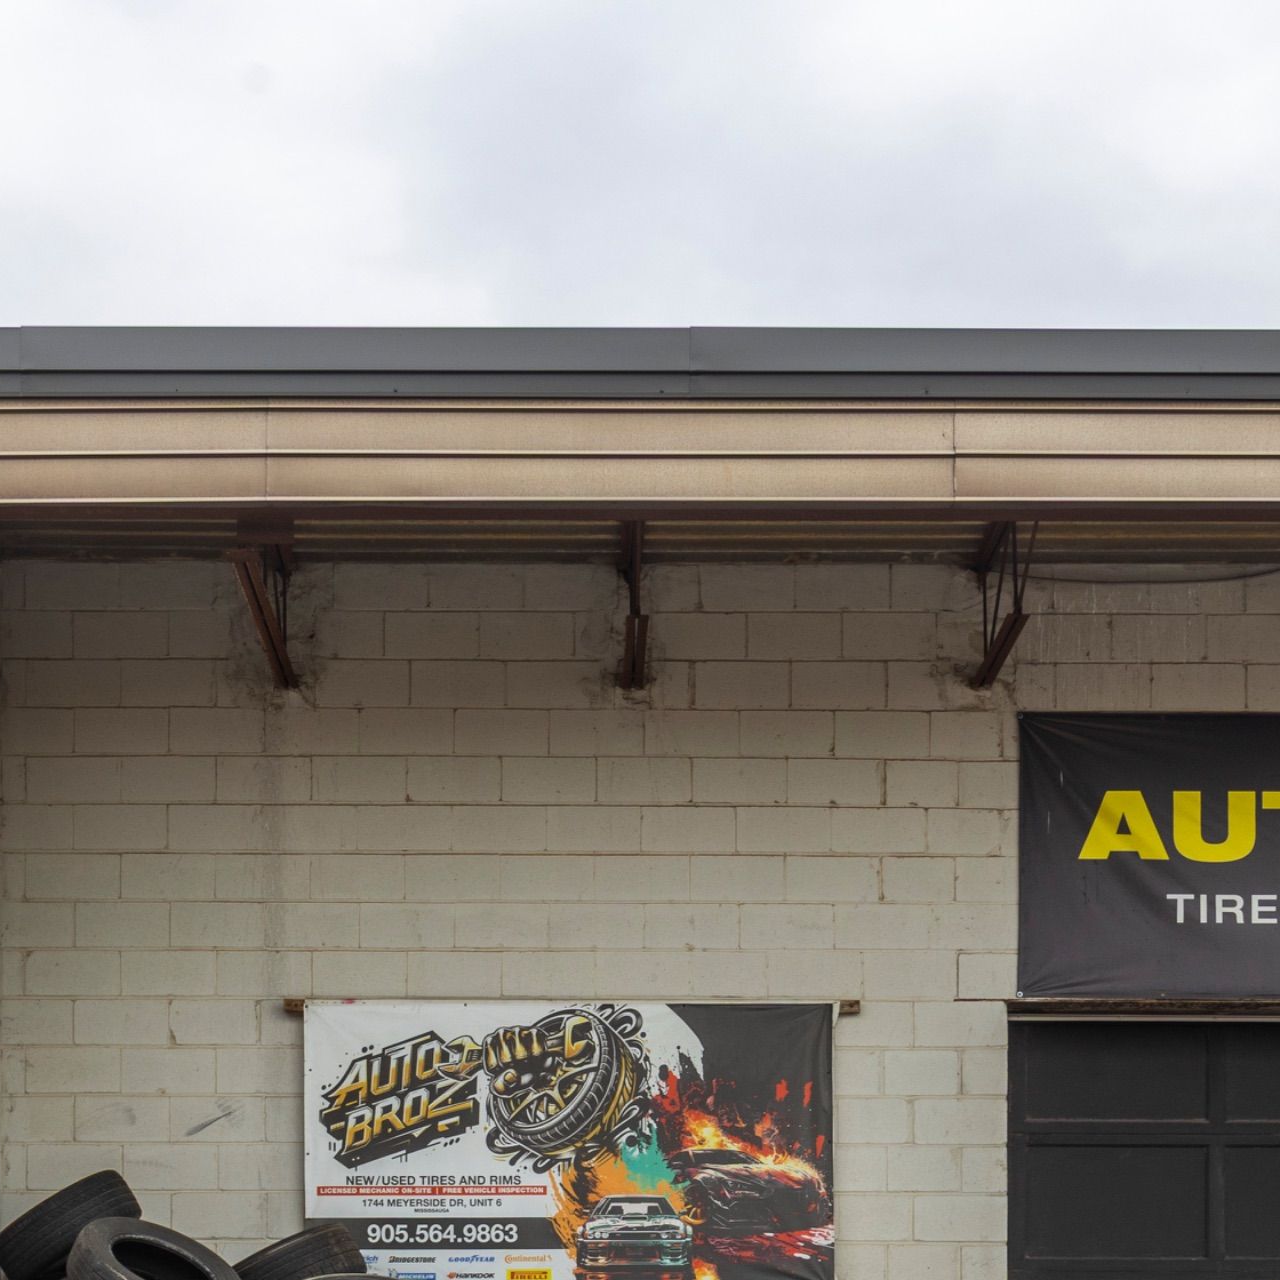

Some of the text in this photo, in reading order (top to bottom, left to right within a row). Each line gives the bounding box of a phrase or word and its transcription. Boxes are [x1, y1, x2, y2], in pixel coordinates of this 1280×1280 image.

[326, 1034, 443, 1112] AUTO
[340, 1077, 477, 1155] BROZ
[346, 1175, 522, 1186] NEW/USED TIRES AND RIMS
[362, 1199, 384, 1207] 1744
[387, 1199, 448, 1207] MEYERSIDE
[470, 1199, 493, 1207] UNIT
[496, 1199, 502, 1207] 6
[367, 1223, 519, 1244] 905.564.9863
[388, 1255, 437, 1263] BRIDGESTONE
[448, 1255, 495, 1264] GOODYEAR
[510, 1271, 549, 1280] PIRELLI
